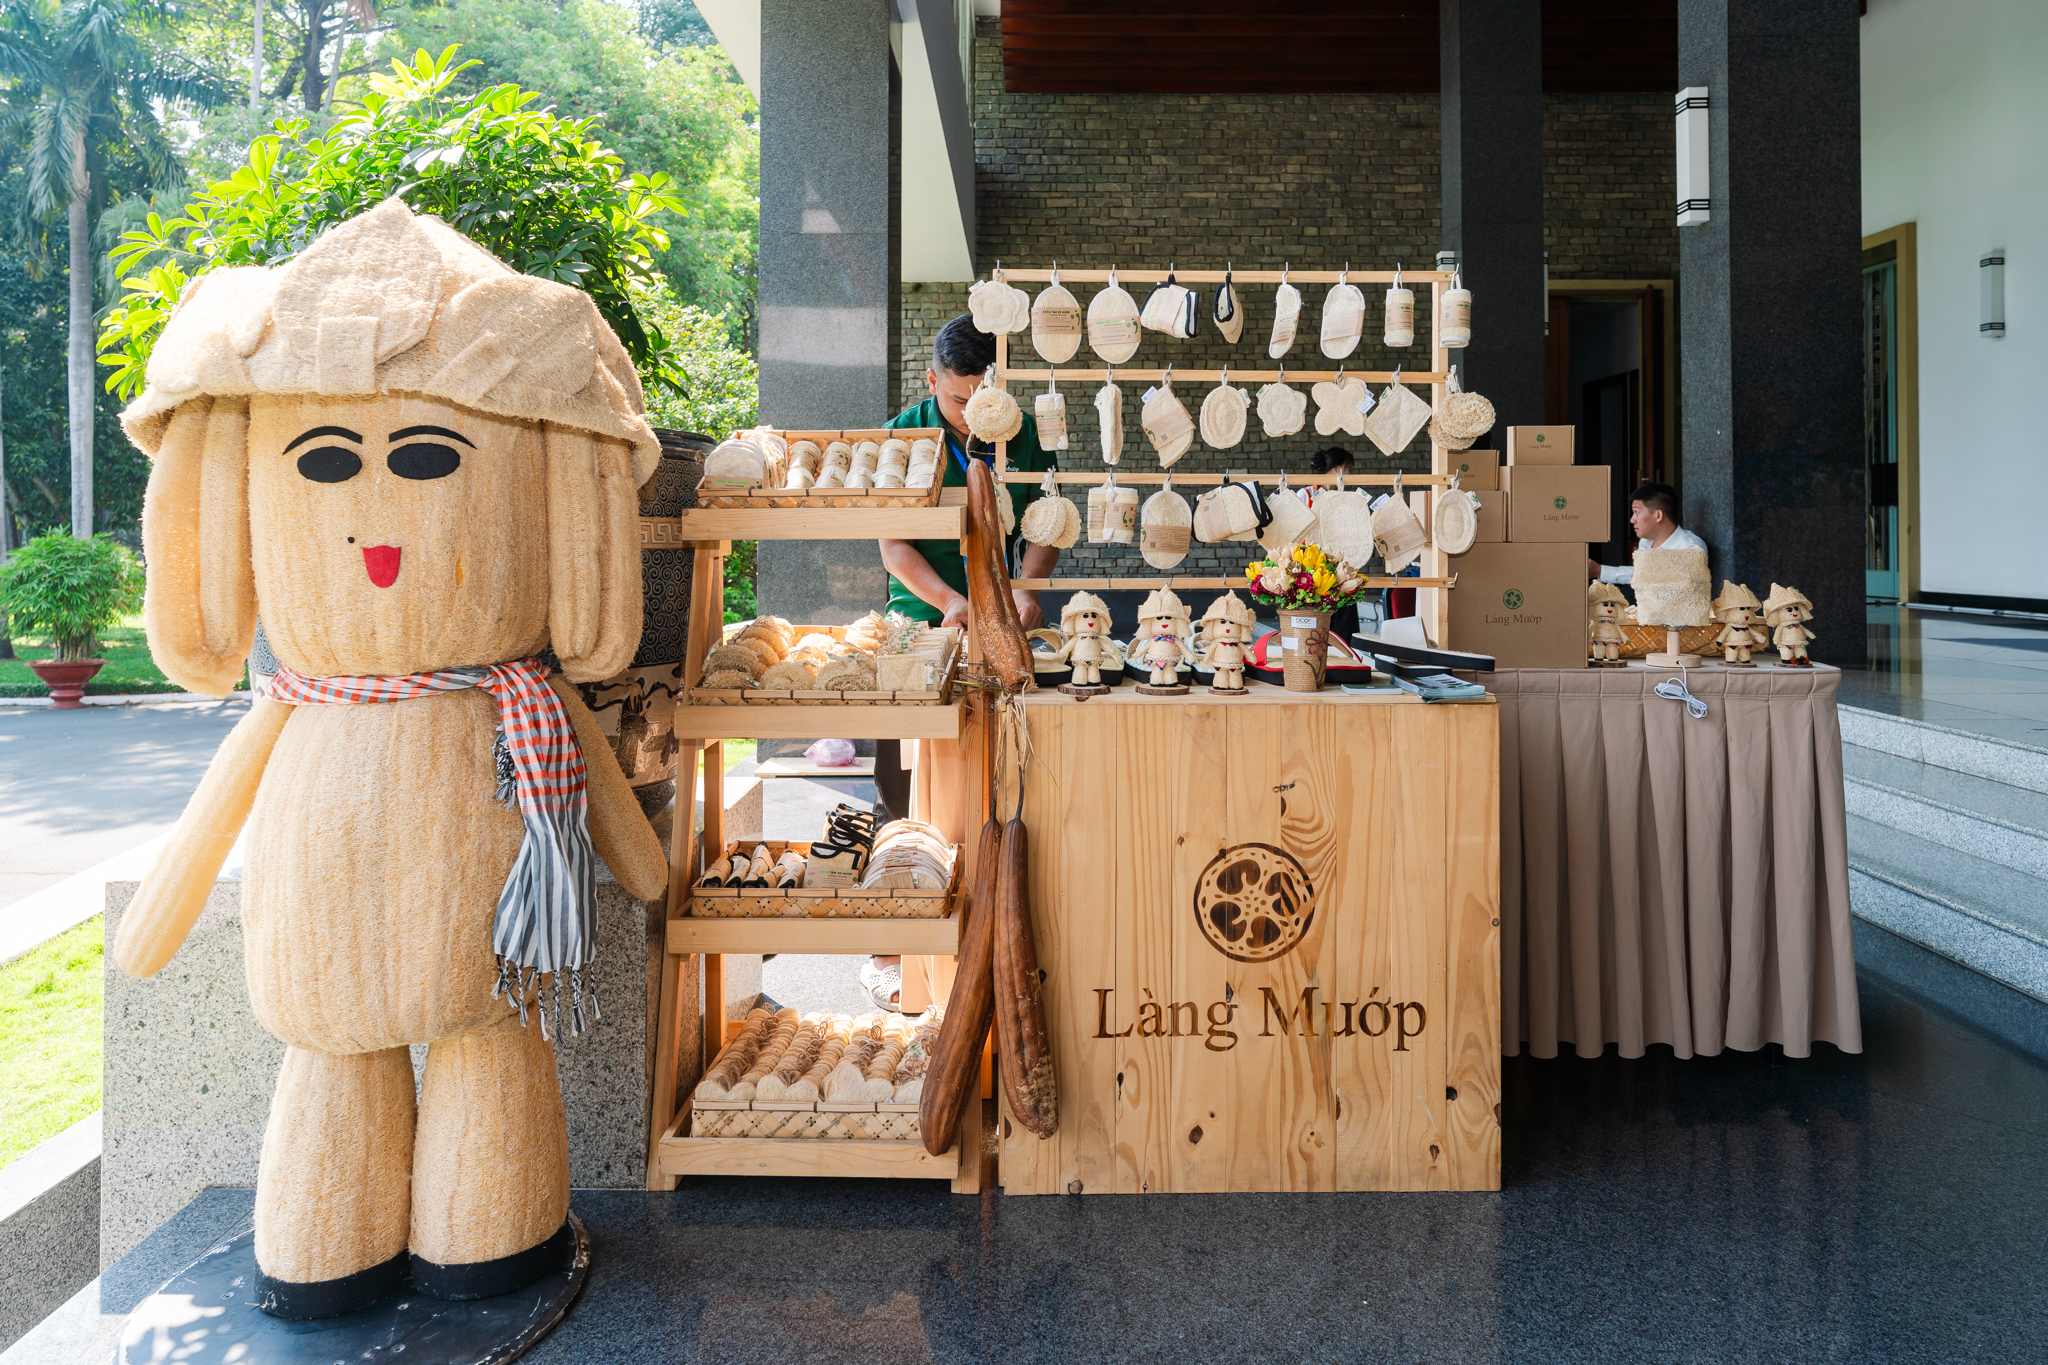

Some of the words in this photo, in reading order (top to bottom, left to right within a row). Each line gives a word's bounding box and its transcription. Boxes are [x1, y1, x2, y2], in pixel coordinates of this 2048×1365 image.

[1485, 613, 1511, 626] Làng
[1513, 613, 1542, 626] Mướp
[1091, 986, 1239, 1053] Làng
[1257, 986, 1427, 1053] Mướp
